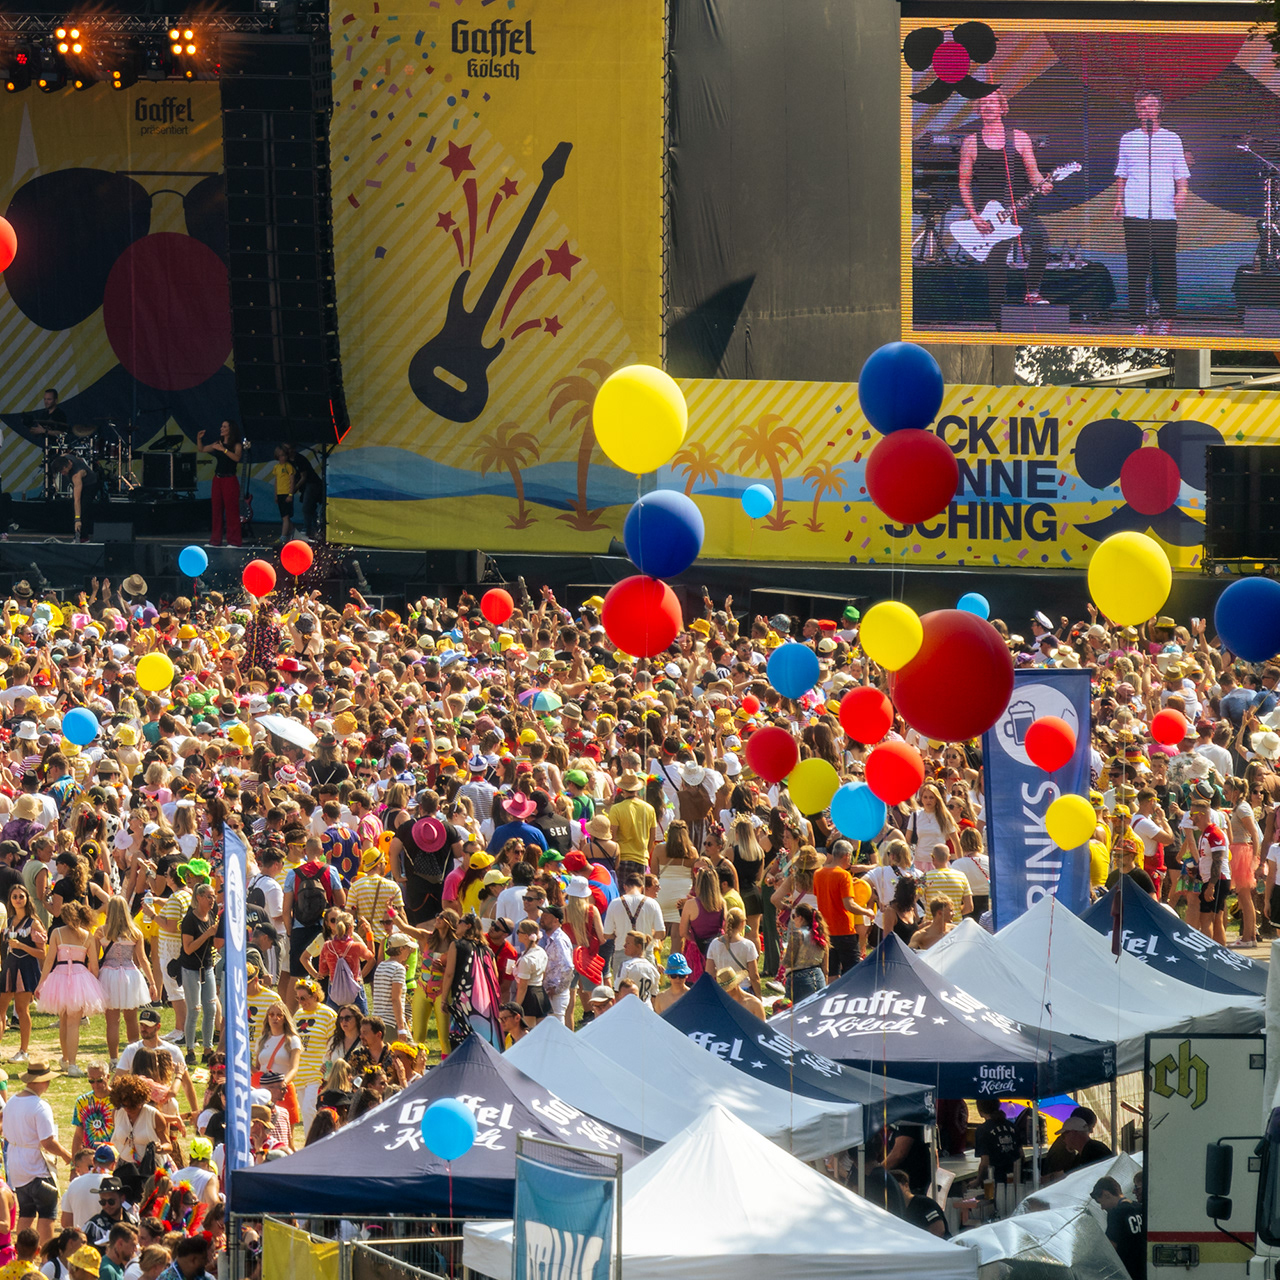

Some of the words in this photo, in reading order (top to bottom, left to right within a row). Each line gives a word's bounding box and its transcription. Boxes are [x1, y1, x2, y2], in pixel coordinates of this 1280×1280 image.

[451, 18, 537, 58] Gaffel
[135, 96, 195, 124] Gaffel
[140, 125, 188, 136] präsentiert
[927, 414, 1000, 455] CK
[1009, 417, 1059, 456] IM
[954, 458, 1058, 499] NNE
[550, 826, 568, 837] SEK
[1021, 780, 1063, 911] RINKS
[819, 990, 927, 1018] Gaffel
[806, 1017, 919, 1039] Kölsch
[688, 1031, 744, 1061] ffel
[234, 965, 249, 1162] DRINKS
[979, 1064, 1017, 1080] Gaffel
[1151, 1039, 1210, 1110] ch
[978, 1080, 1017, 1095] Kölsch
